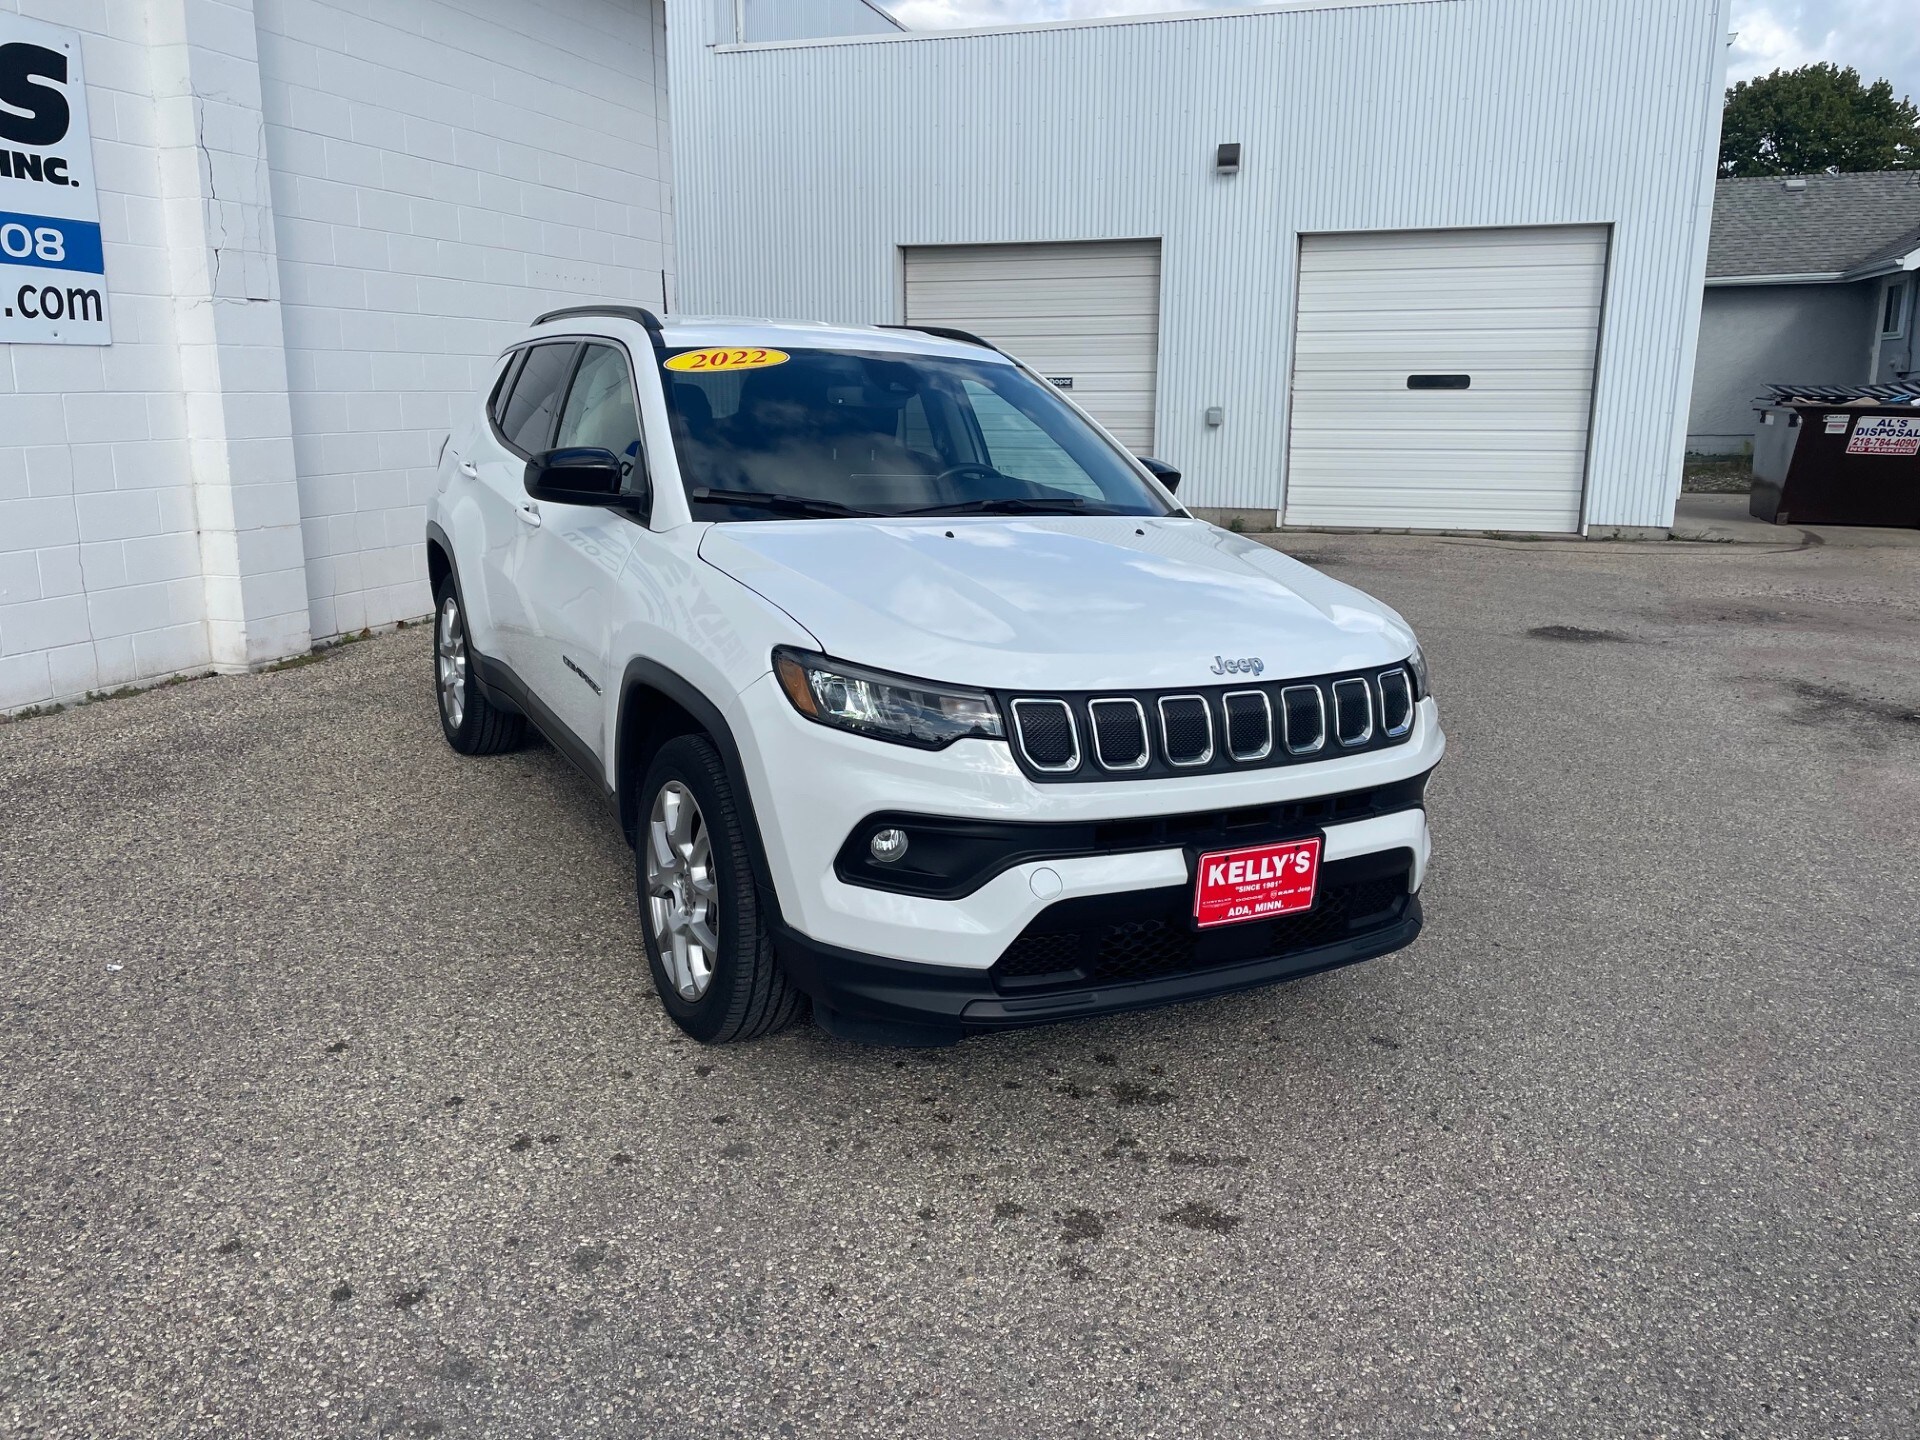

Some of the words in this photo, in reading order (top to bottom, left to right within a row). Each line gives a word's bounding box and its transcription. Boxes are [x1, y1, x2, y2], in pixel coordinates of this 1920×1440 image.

[0, 149, 80, 187] INC.
[1, 223, 66, 262] 08
[5, 284, 103, 322] .com
[690, 350, 767, 369] 2022
[1855, 427, 1920, 438] DISPOSAL
[1876, 419, 1909, 428] AL'S
[1852, 437, 1918, 447] 218-784-4090
[1210, 655, 1264, 676] Jeep
[1207, 850, 1311, 887] KELLY'S
[1228, 905, 1252, 917] ADA,
[1255, 900, 1284, 912] MINN.
